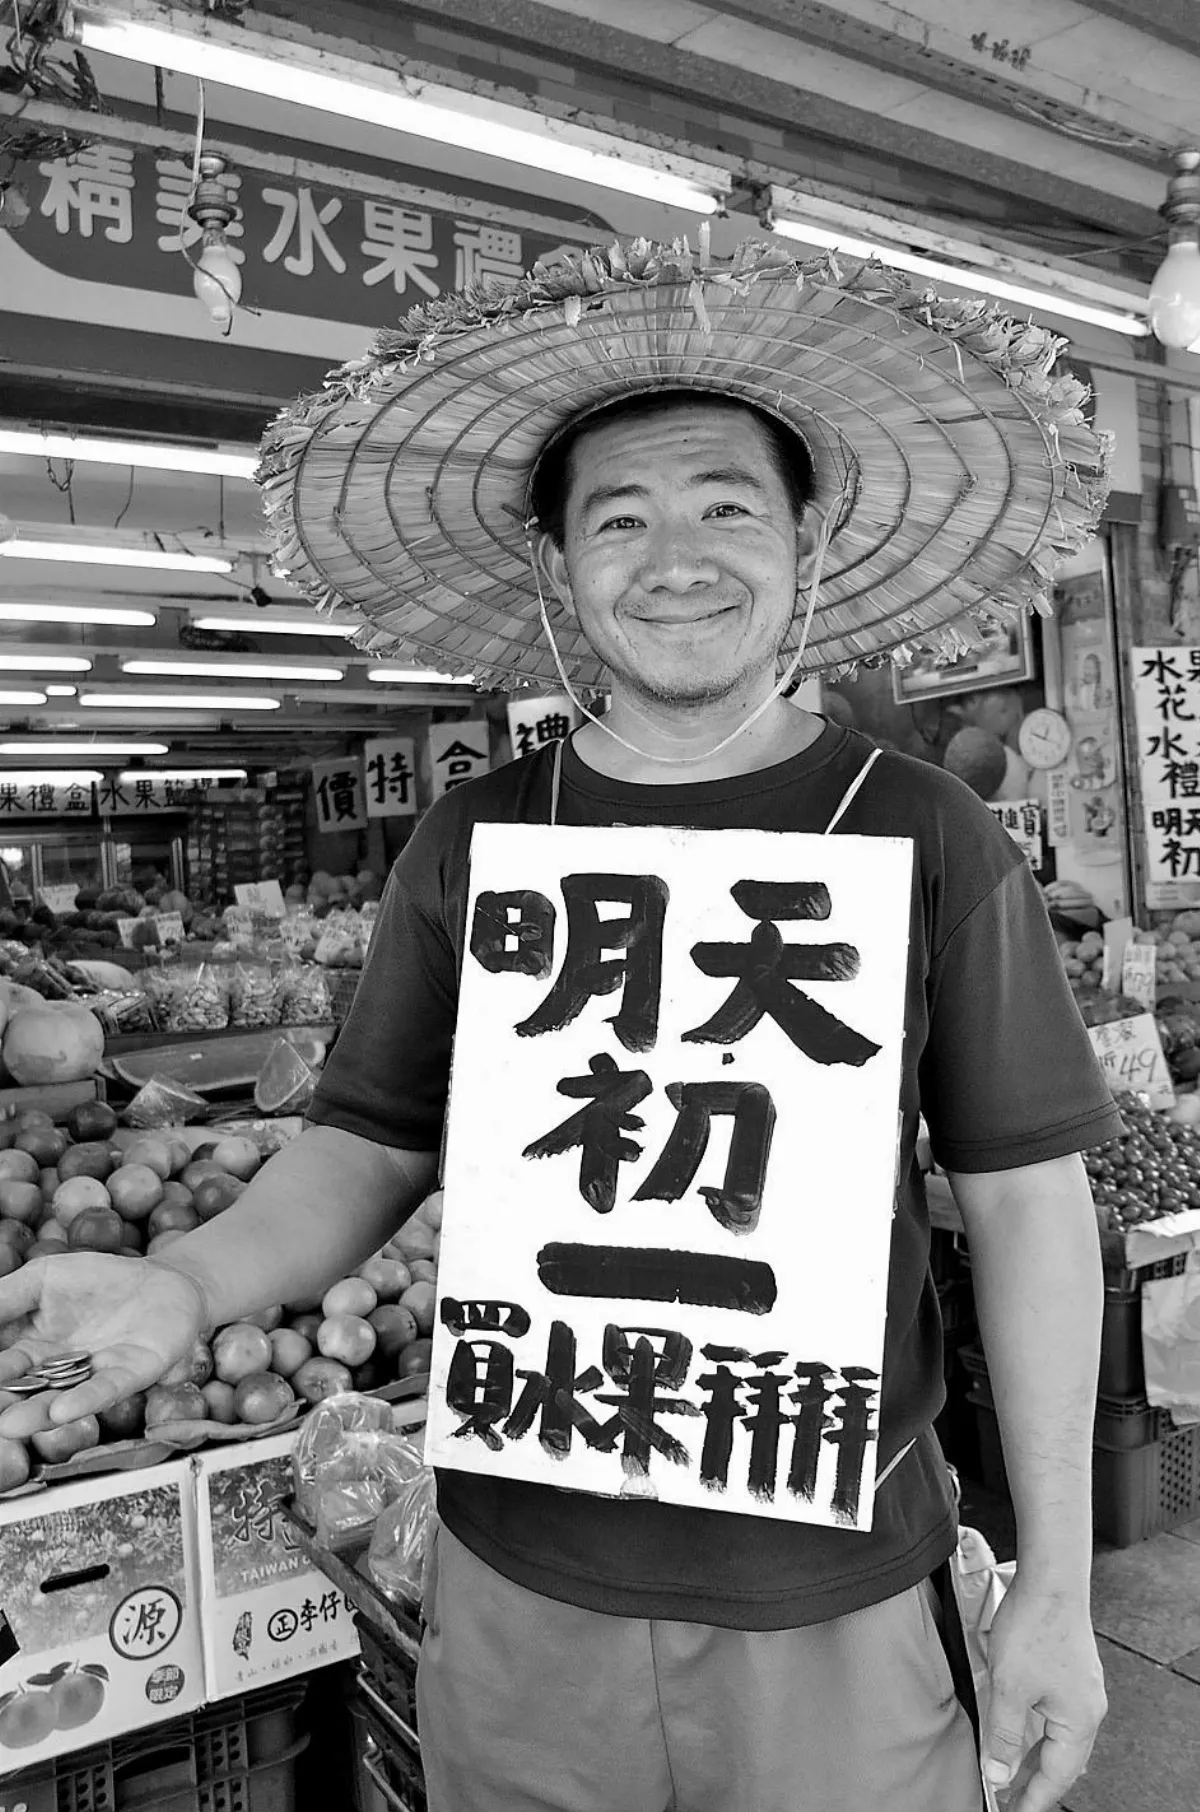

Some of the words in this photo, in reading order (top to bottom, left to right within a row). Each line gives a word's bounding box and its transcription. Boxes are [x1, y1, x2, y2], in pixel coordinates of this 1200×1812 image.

[470, 873, 883, 1067] 明天
[522, 1053, 775, 1234] 初
[536, 1241, 776, 1315] 一
[241, 1556, 299, 1583] TAIWAN
[124, 1597, 167, 1646] 源
